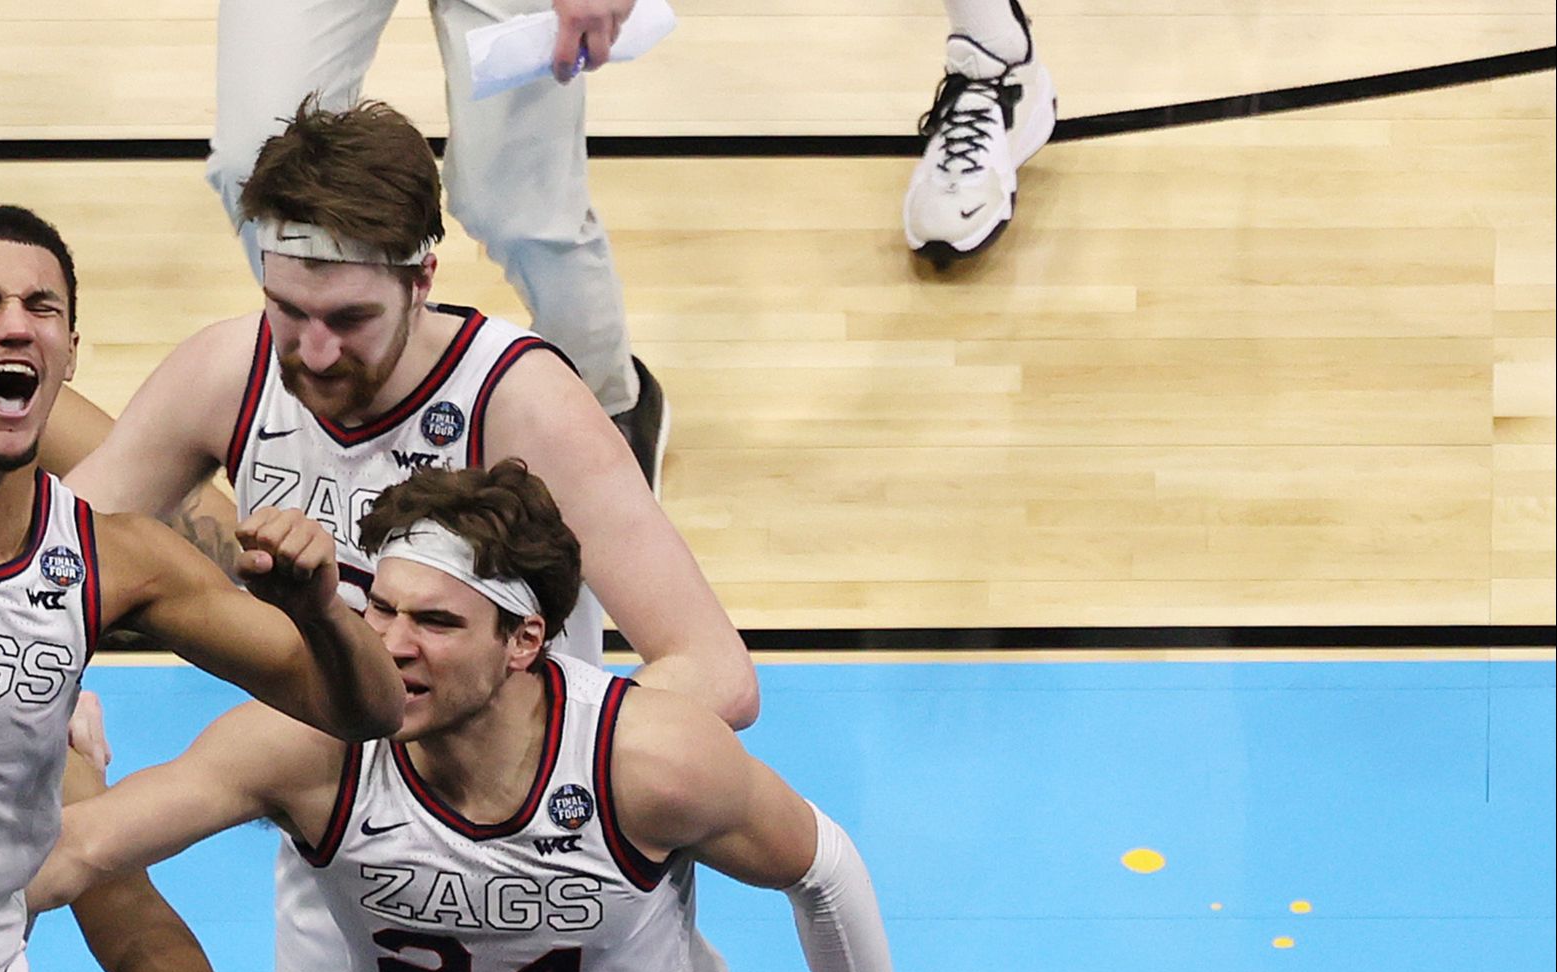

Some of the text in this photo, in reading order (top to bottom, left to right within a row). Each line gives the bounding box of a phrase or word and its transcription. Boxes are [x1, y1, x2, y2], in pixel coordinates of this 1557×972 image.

[430, 412, 456, 425] FINAL
[428, 423, 455, 437] FOUR
[48, 556, 76, 567] FINAL
[49, 566, 77, 578] FOUR
[556, 795, 584, 810] FINAL
[558, 807, 585, 821] FOUR
[360, 864, 603, 932] ZAGS
